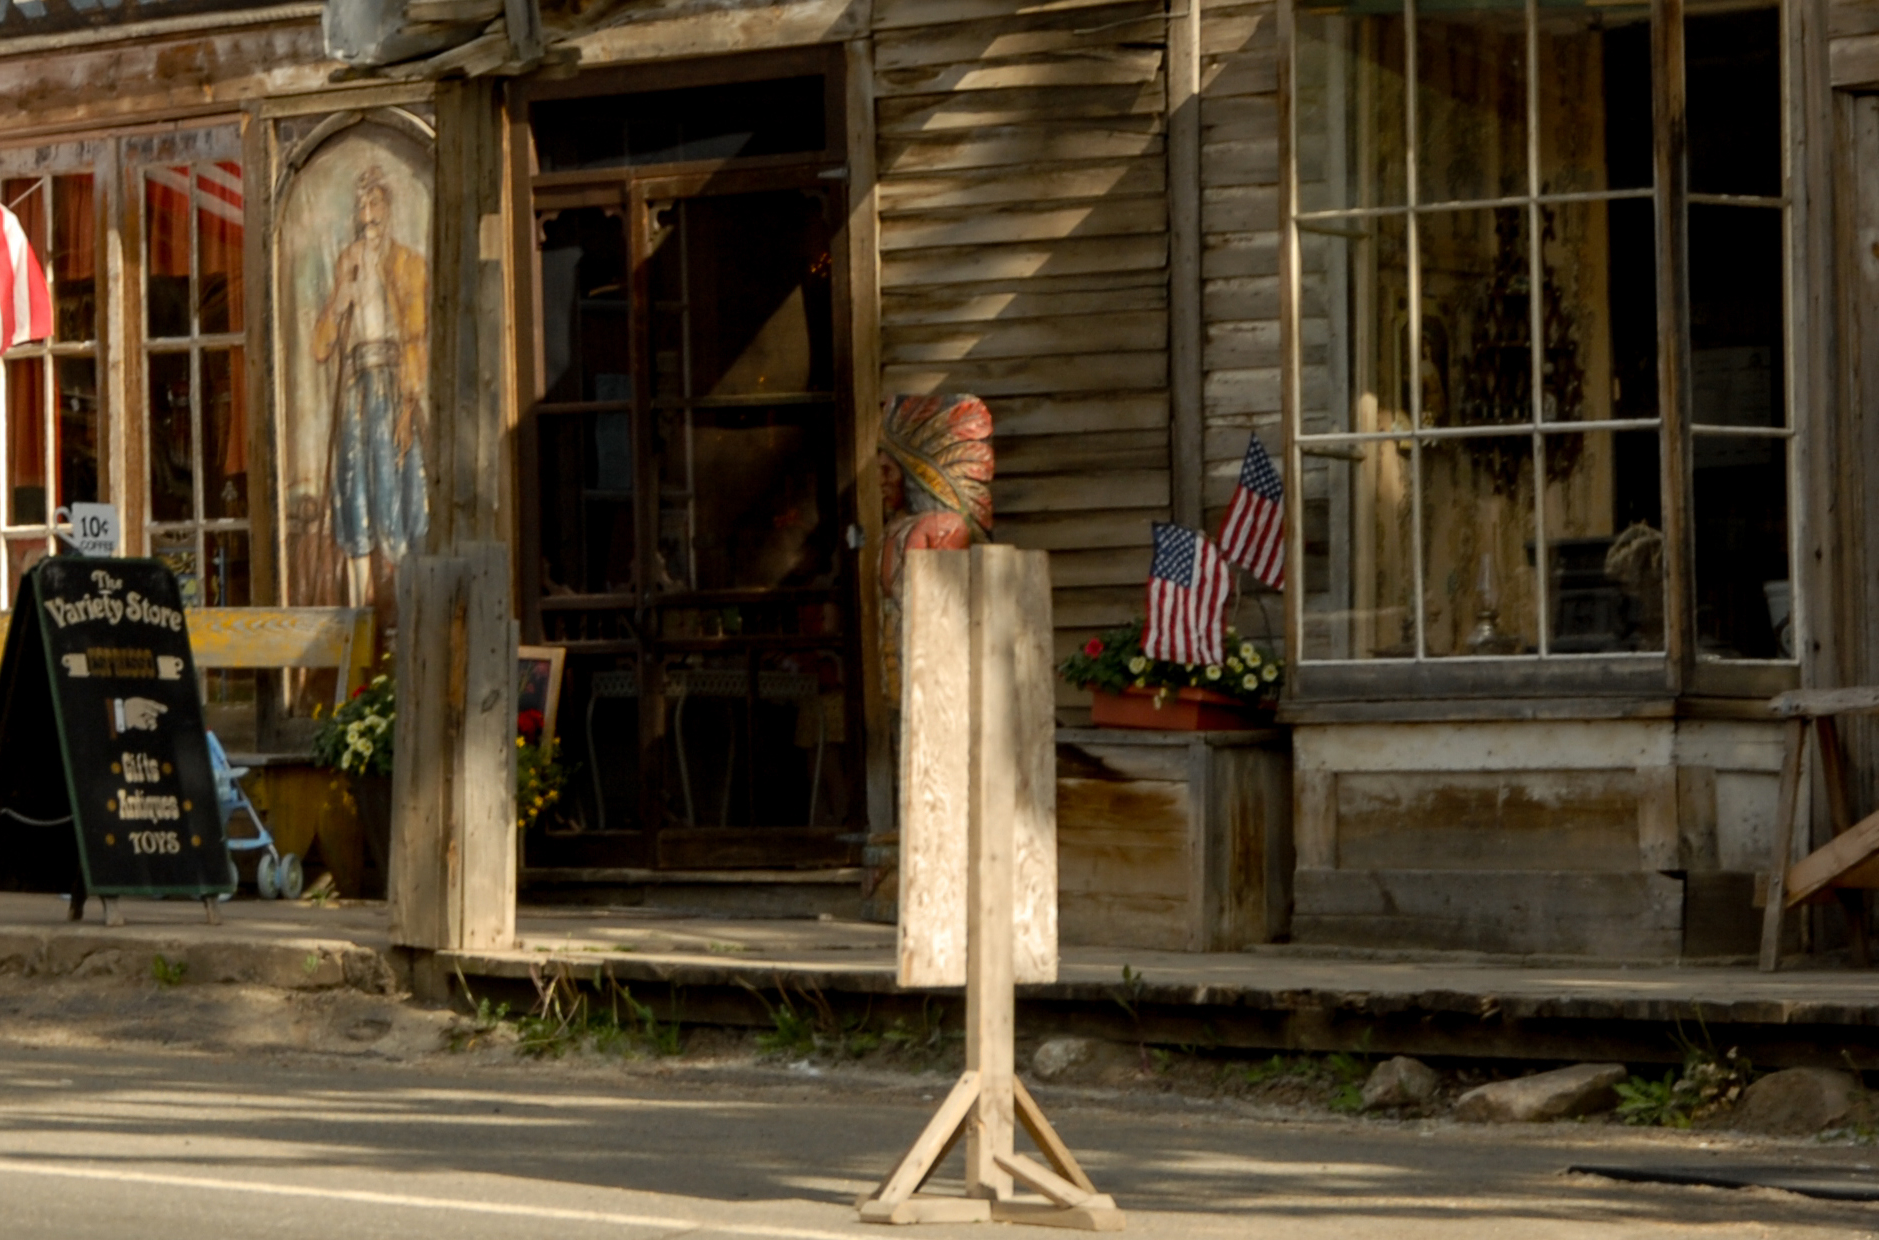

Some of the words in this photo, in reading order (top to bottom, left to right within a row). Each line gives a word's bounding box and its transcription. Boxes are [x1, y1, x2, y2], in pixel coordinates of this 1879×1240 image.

[80, 515, 110, 538] 10¢
[80, 540, 115, 552] COFFEE
[91, 569, 123, 591] The
[44, 590, 124, 628] Variety
[126, 591, 182, 632] Store
[121, 752, 161, 783] Gifts
[117, 788, 180, 824] Antiques
[129, 830, 180, 855] TOYS
